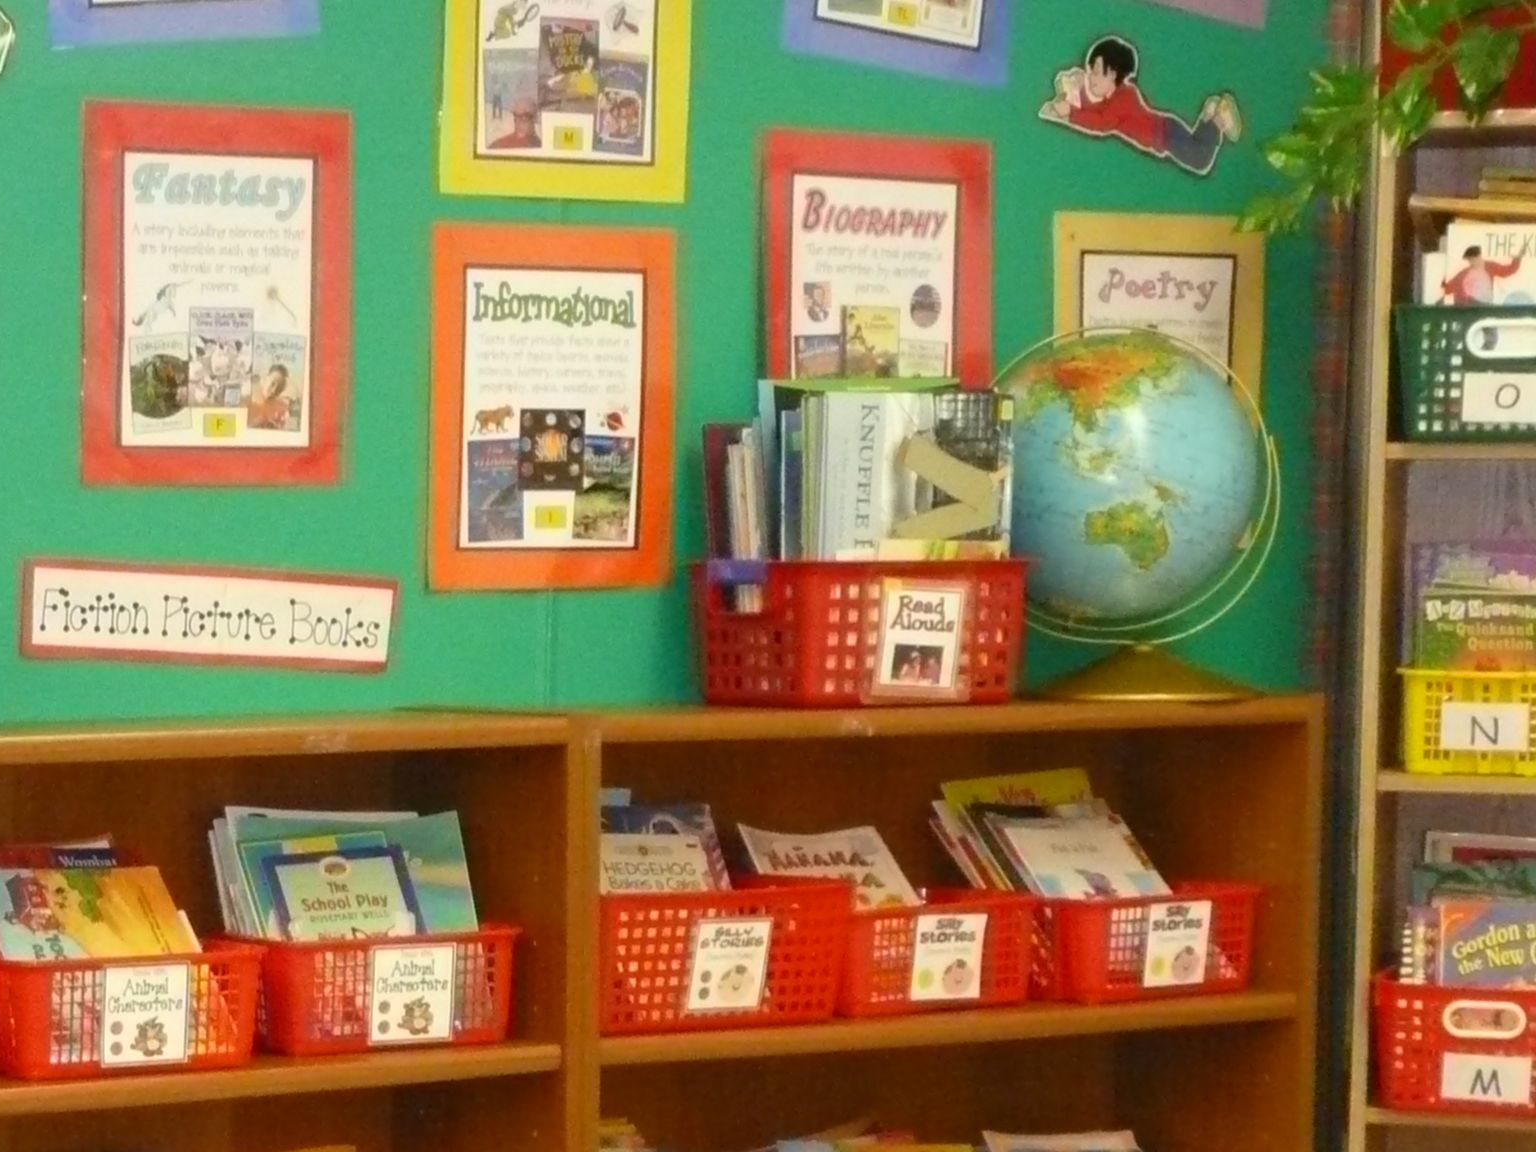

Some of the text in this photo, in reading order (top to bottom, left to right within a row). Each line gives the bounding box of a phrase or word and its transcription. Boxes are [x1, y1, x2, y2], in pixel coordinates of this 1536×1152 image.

[130, 161, 307, 223] Fantasy
[800, 186, 948, 240] BIOGRAPHY
[1486, 233, 1517, 258] THE
[1097, 266, 1220, 313] Poetry
[471, 280, 637, 329] Informational
[1495, 383, 1521, 409] O
[898, 594, 946, 614] Read
[38, 587, 381, 649] Fiction Picture Books
[889, 612, 955, 633] Alouds
[1470, 715, 1499, 746] N
[602, 861, 697, 876] HEDGEHOG
[326, 881, 349, 893] The
[300, 893, 388, 913] School Play
[1165, 904, 1191, 919] Silly
[935, 917, 965, 932] Silly
[1150, 916, 1204, 933] Stories
[919, 930, 977, 946] Stories
[1451, 921, 1521, 960] Gordon
[390, 959, 435, 977] Animal
[1457, 948, 1526, 977] the New
[122, 978, 169, 997] Animal
[1469, 1068, 1502, 1098] M
